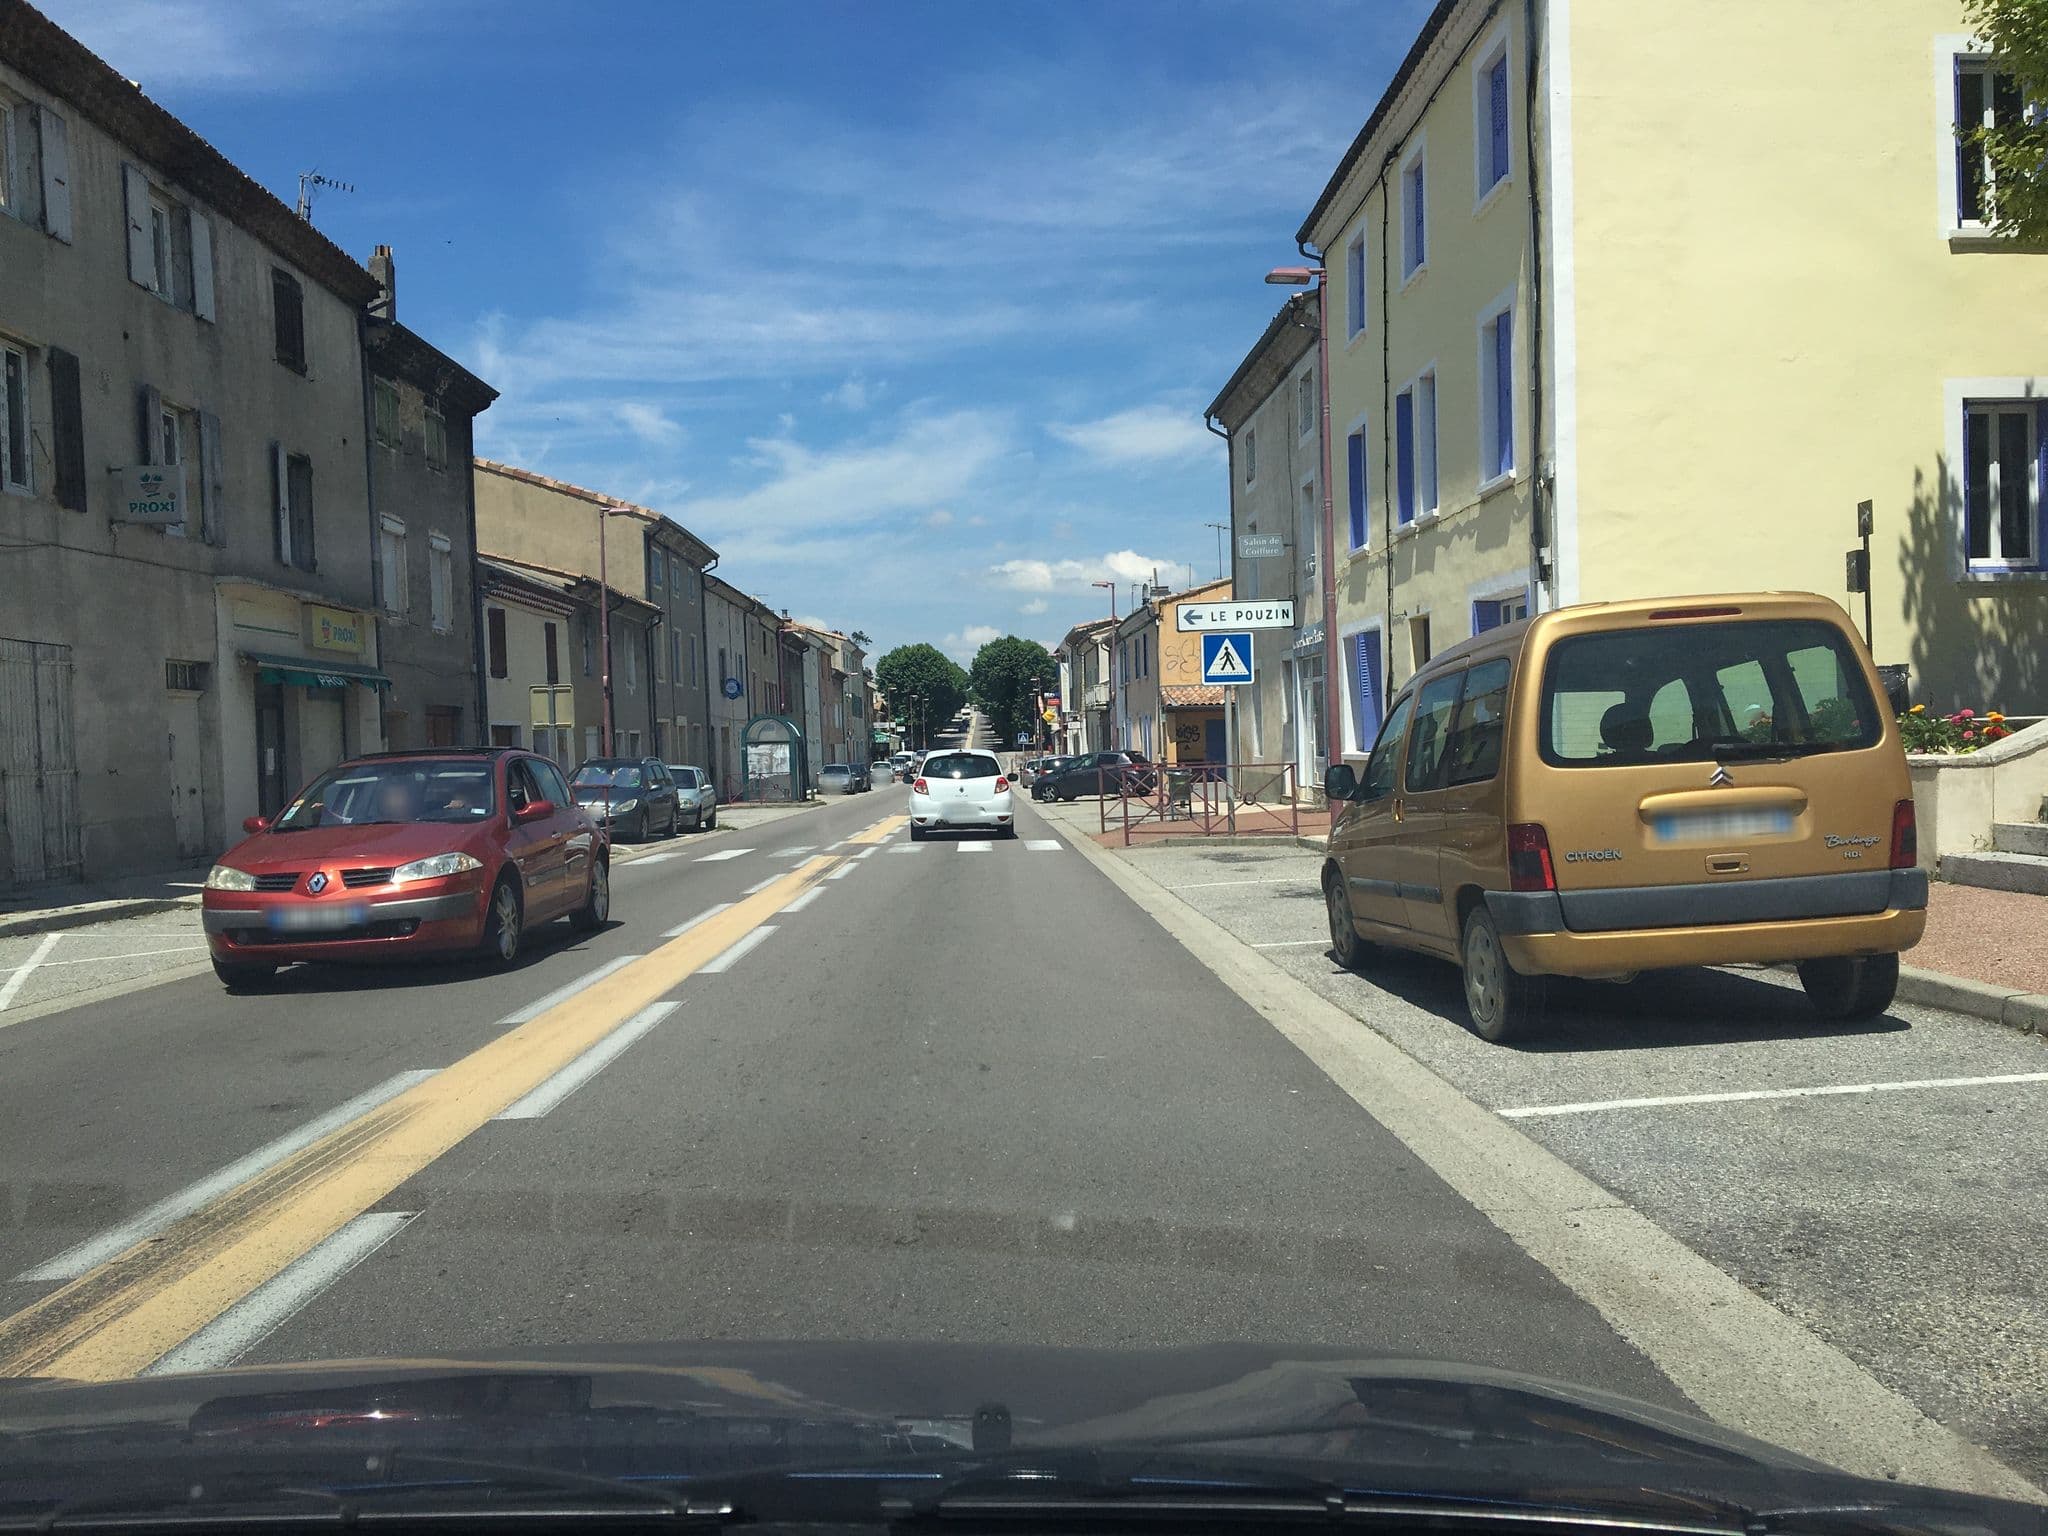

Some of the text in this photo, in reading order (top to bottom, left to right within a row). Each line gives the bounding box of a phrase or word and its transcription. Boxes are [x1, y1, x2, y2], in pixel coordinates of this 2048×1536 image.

[128, 501, 175, 513] PROXI
[1243, 537, 1280, 546] Salon de
[1245, 547, 1279, 555] Coiffure
[1211, 608, 1289, 621] LE POUZIN
